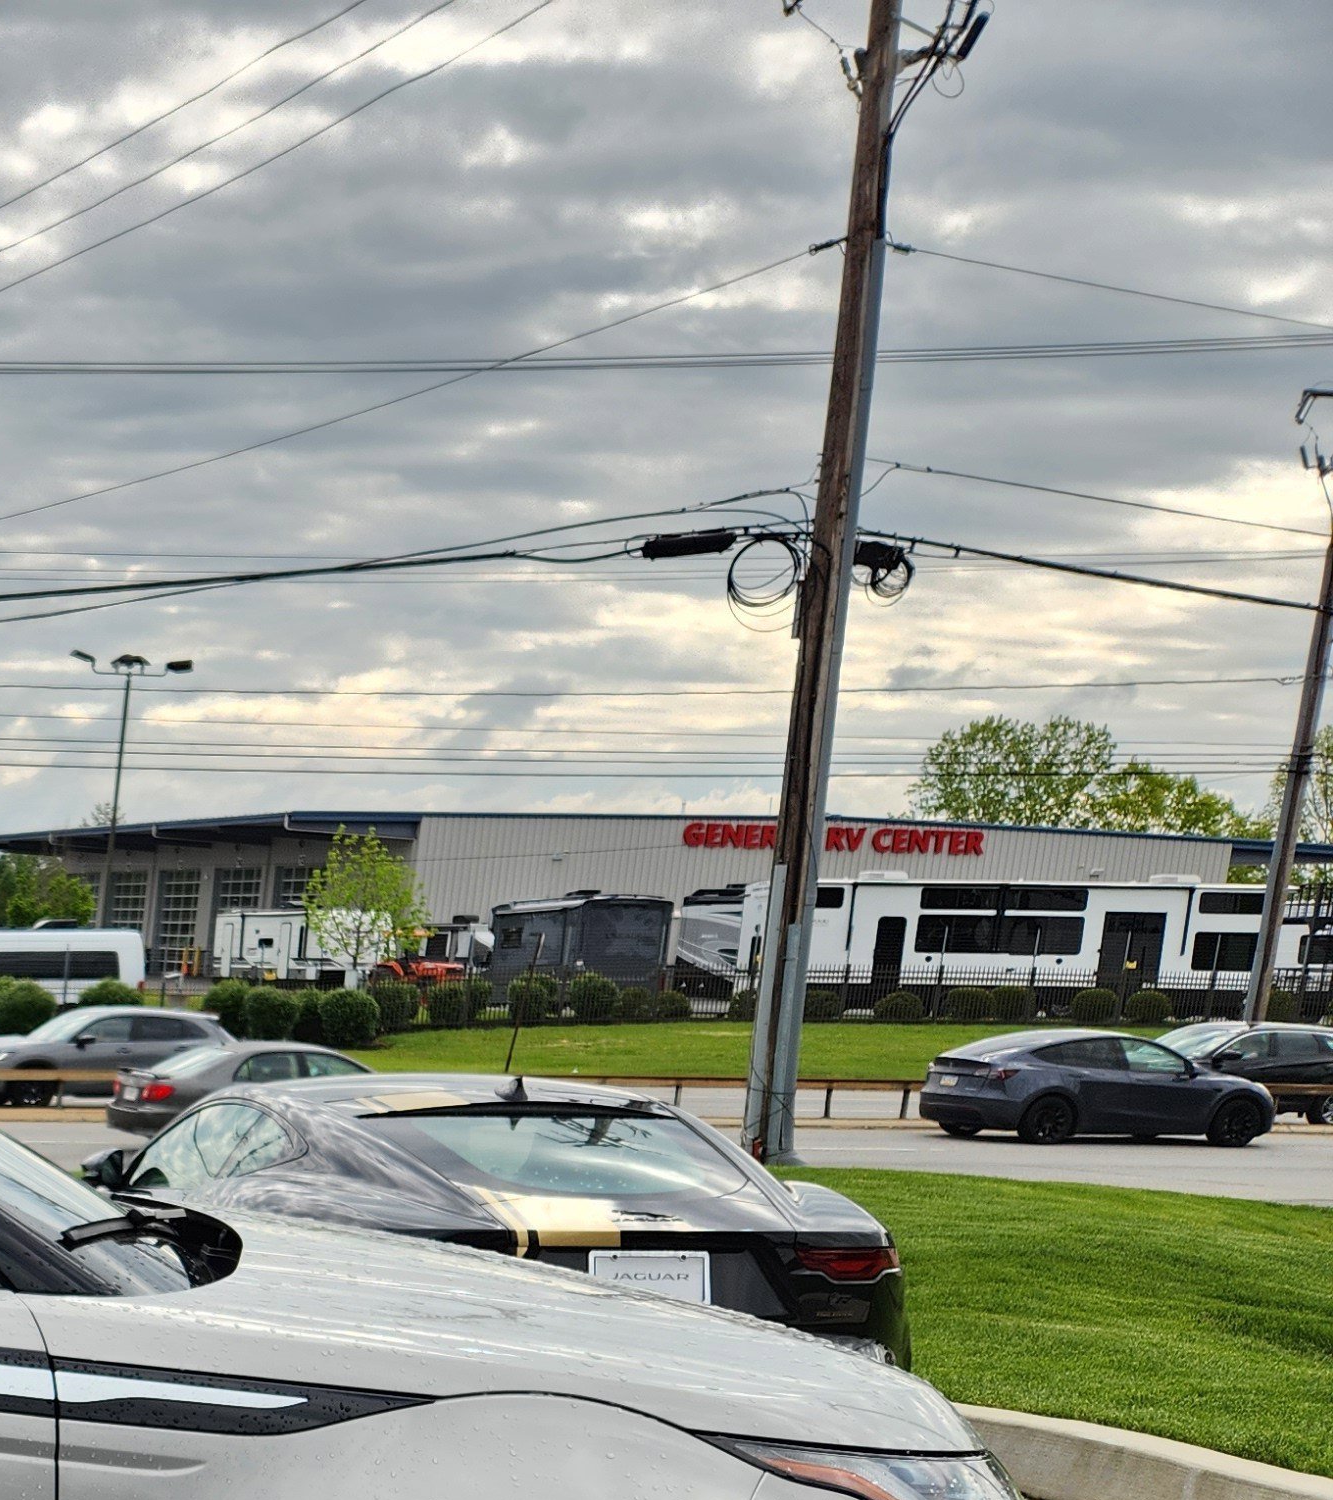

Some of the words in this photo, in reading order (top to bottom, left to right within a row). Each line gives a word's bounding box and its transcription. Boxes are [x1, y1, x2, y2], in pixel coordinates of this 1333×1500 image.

[683, 822, 777, 850] GENER
[824, 826, 867, 852] RV
[871, 828, 985, 856] CENTER
[612, 1272, 691, 1282] JAGUAR
